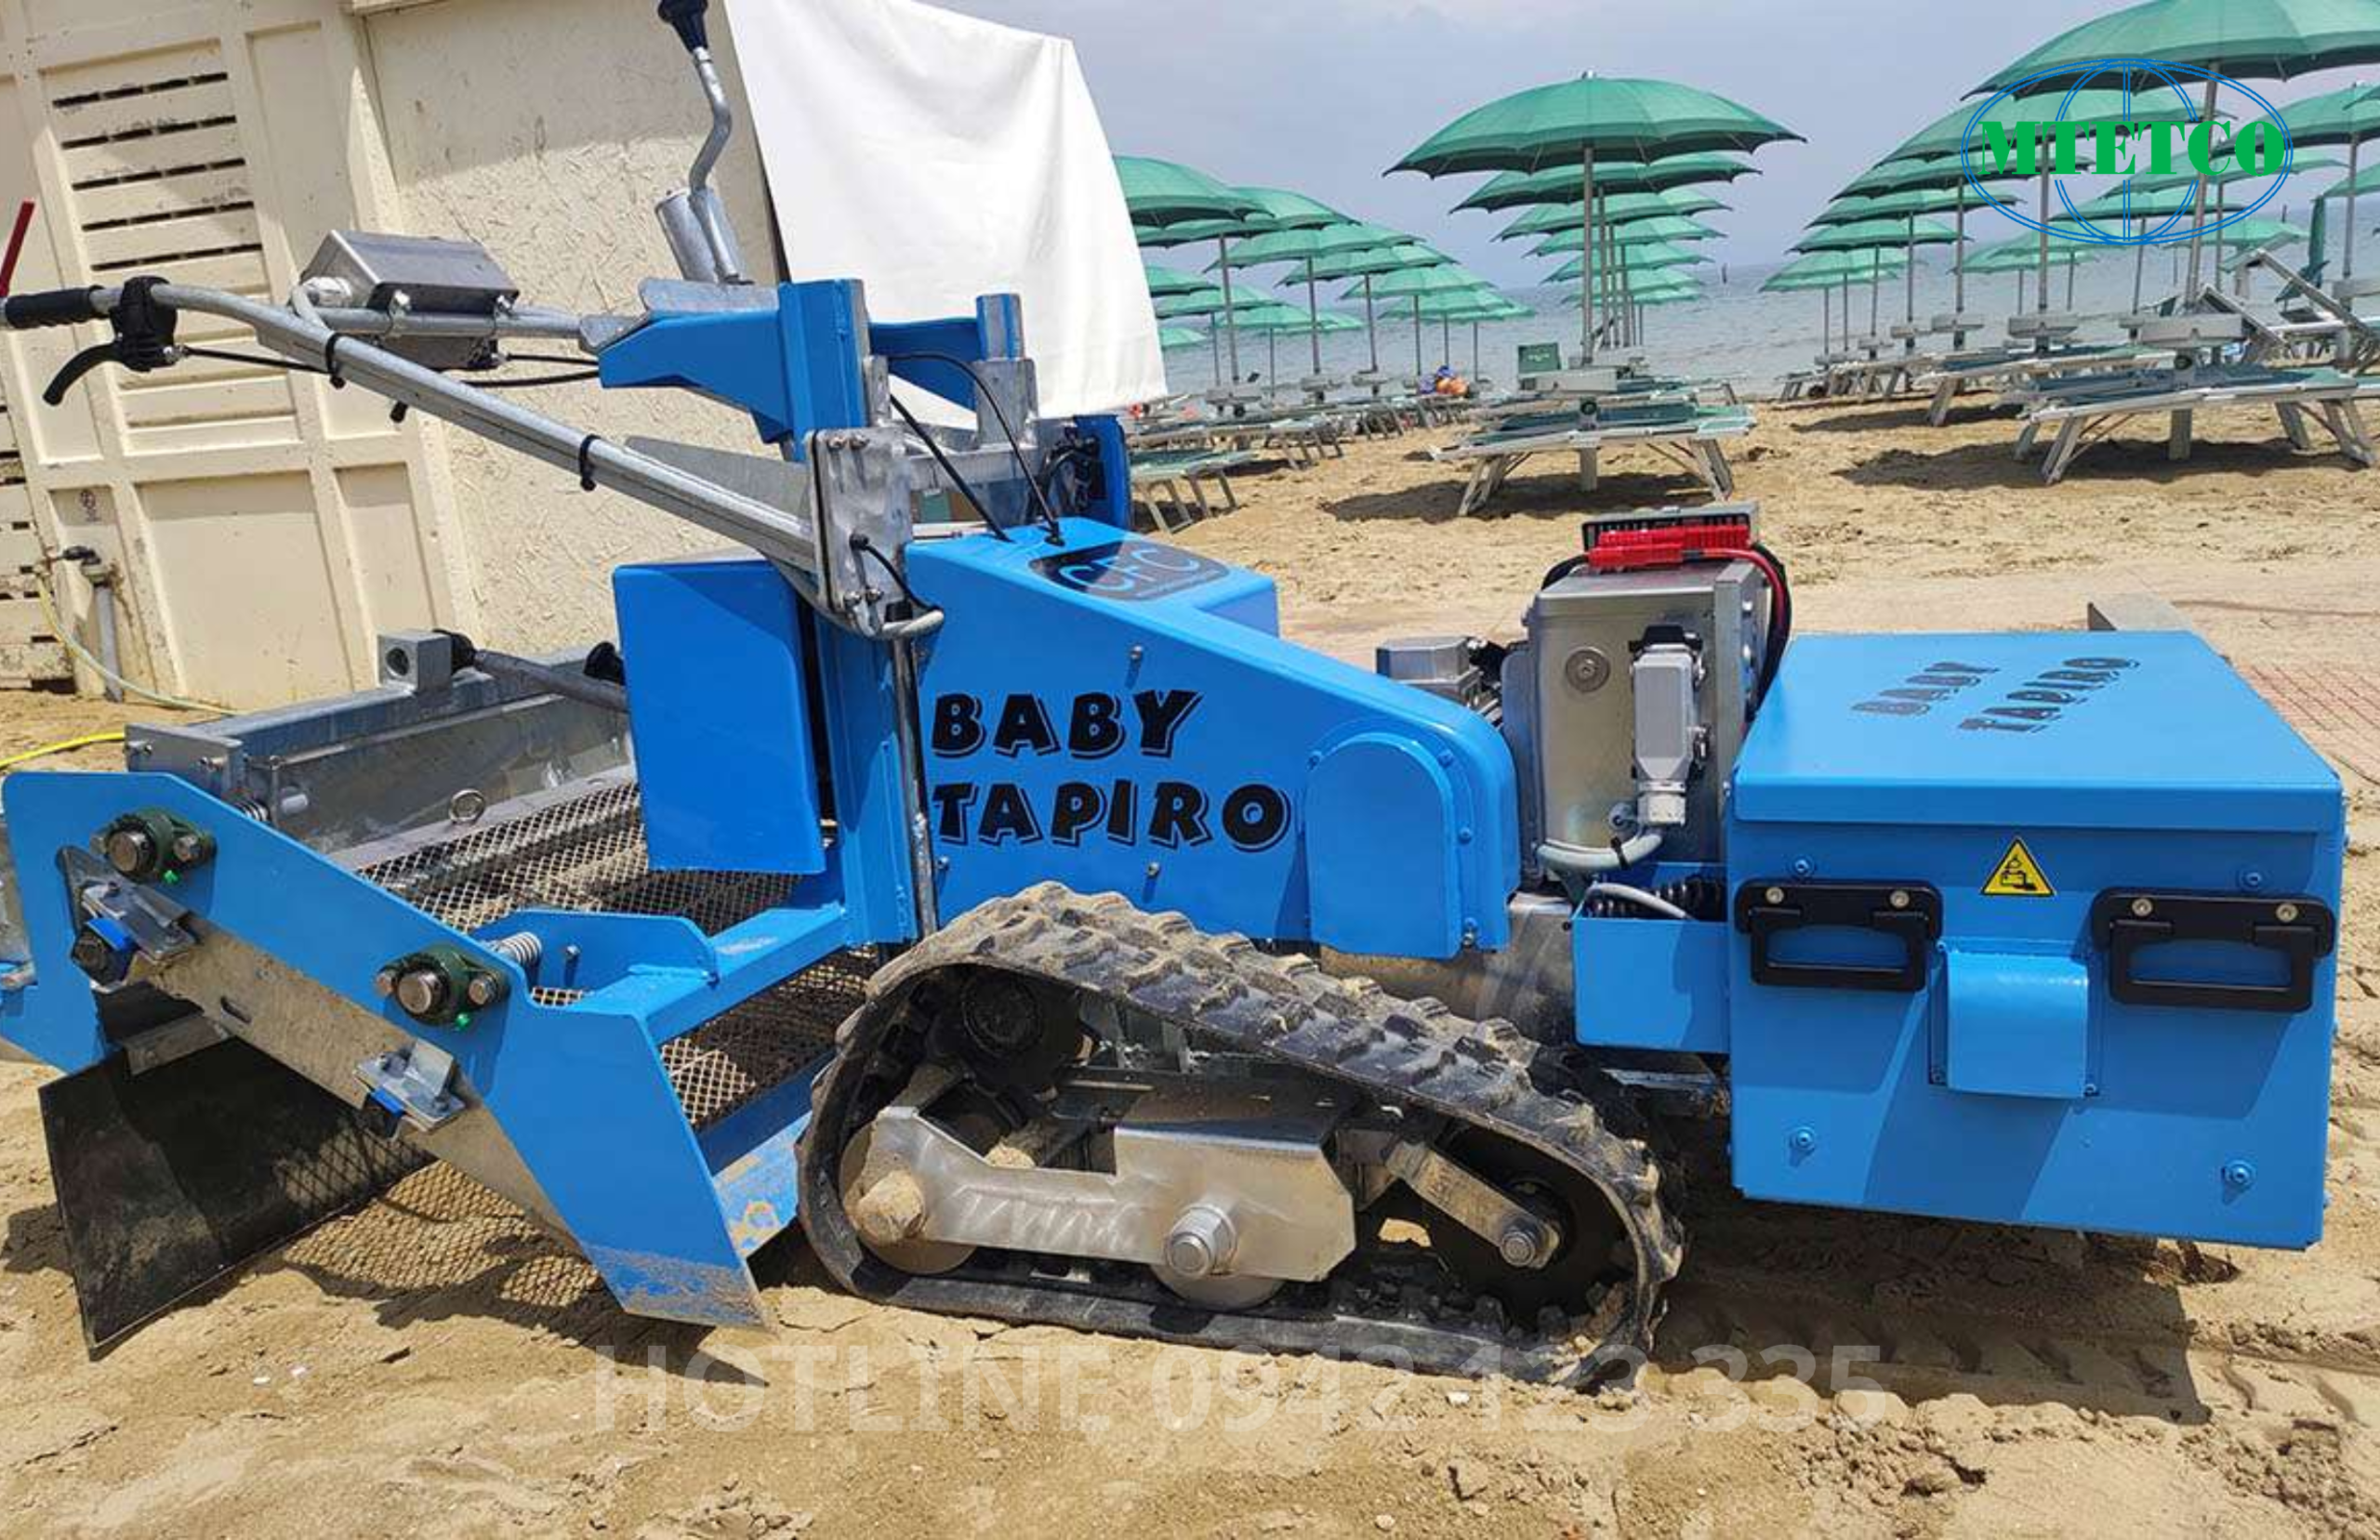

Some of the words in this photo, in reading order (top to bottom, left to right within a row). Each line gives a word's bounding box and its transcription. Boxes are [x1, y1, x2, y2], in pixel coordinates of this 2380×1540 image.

[1850, 662, 2001, 716] BABY
[1958, 657, 2140, 733] TAPIRO
[931, 690, 1203, 760] BABY
[932, 779, 1292, 852] TAPIRO
